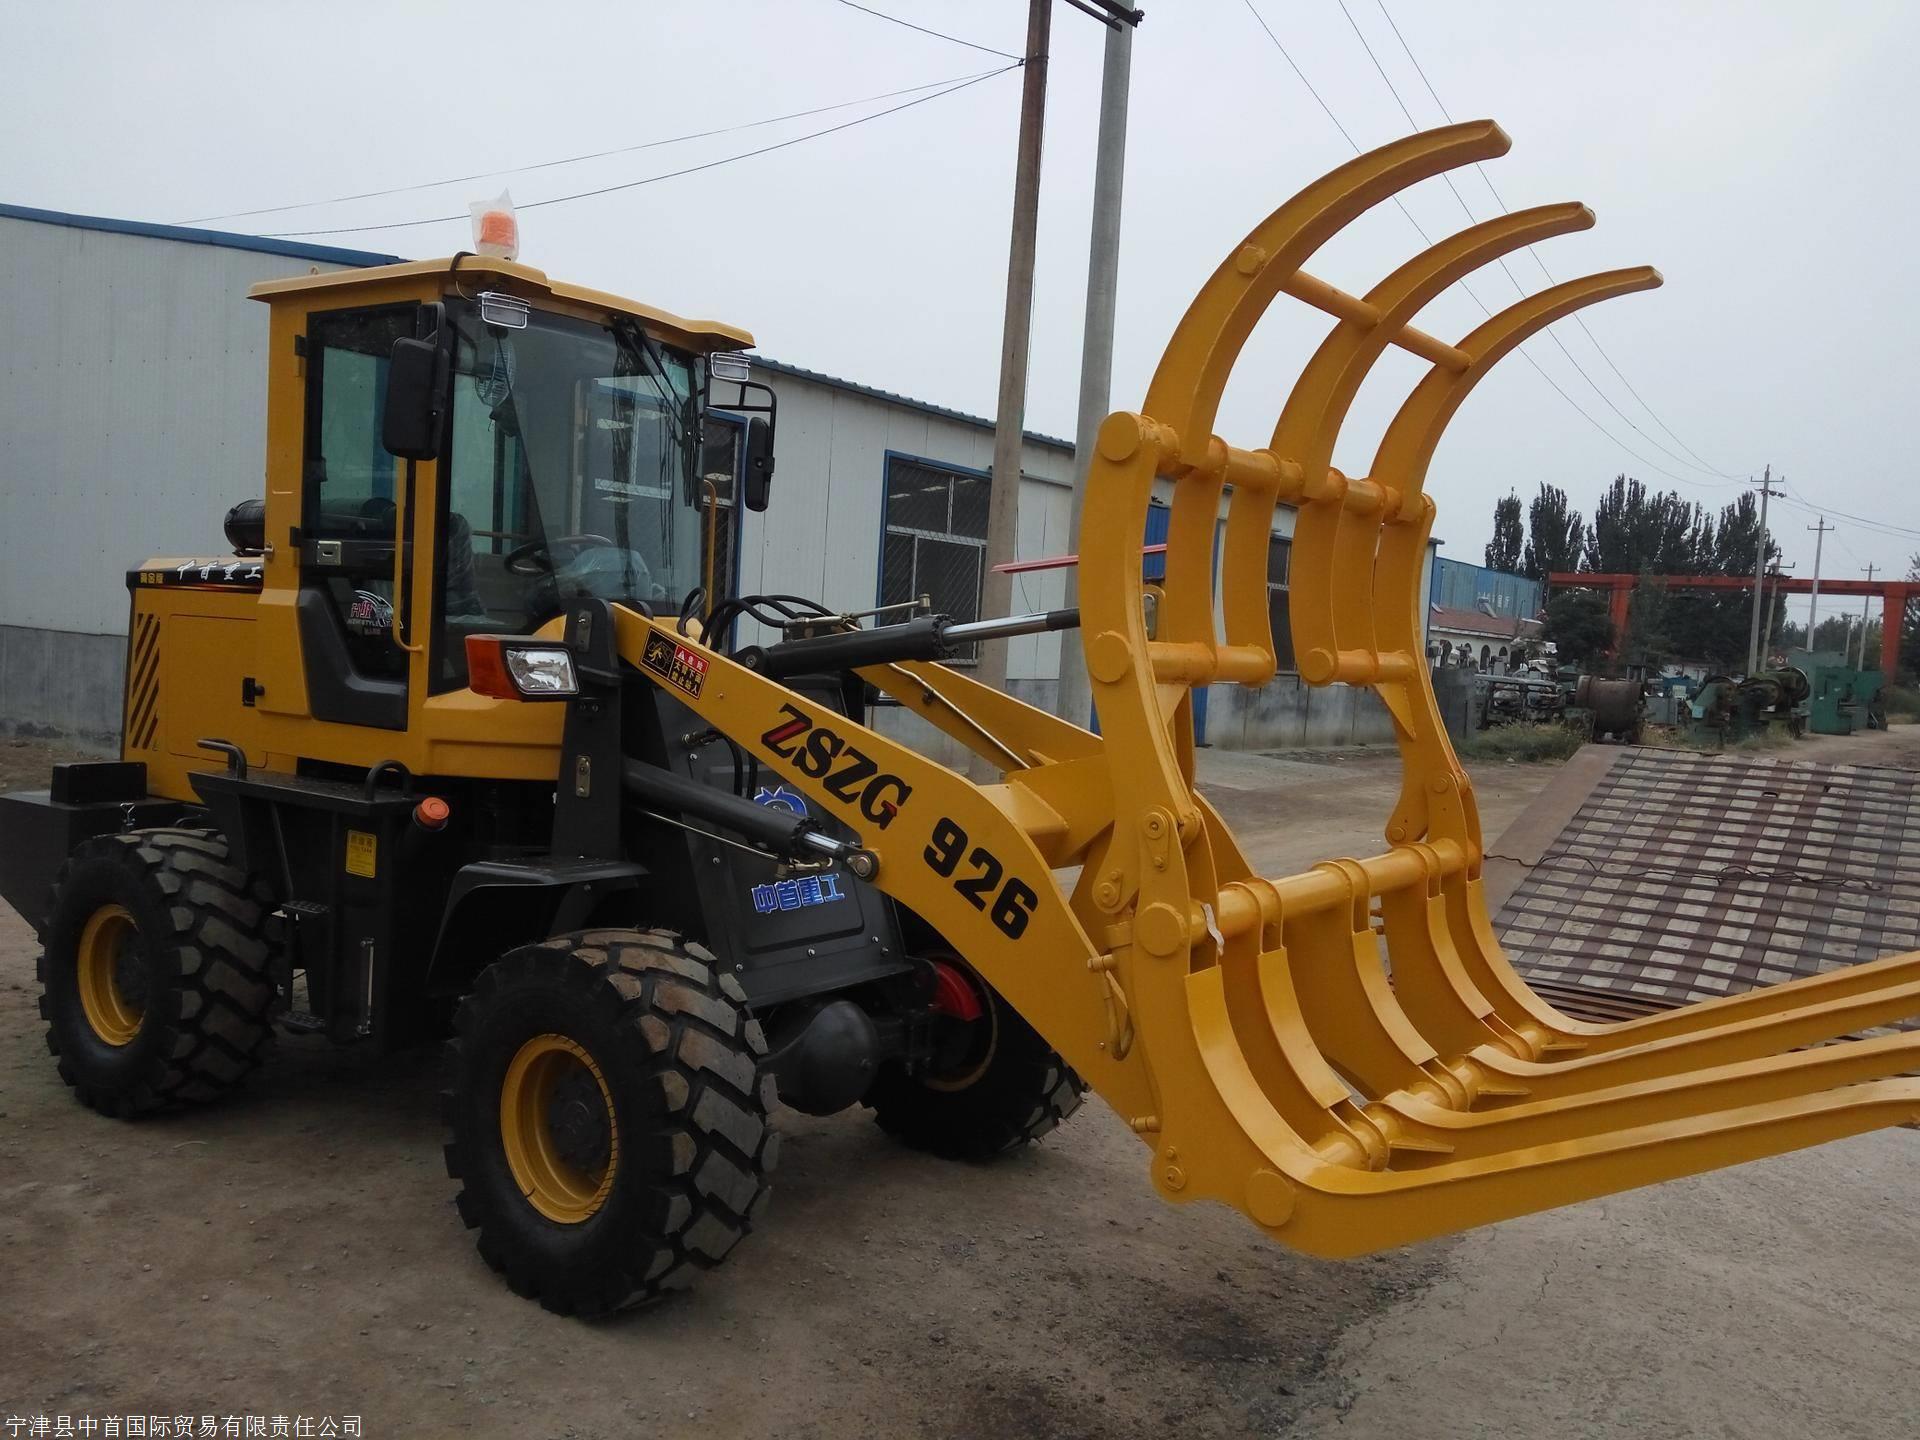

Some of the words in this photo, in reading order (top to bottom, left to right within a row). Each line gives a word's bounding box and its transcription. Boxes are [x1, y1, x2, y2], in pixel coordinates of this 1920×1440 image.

[761, 703, 912, 830] ZSZG
[923, 817, 1039, 940] 926
[751, 873, 845, 913] 中首重工
